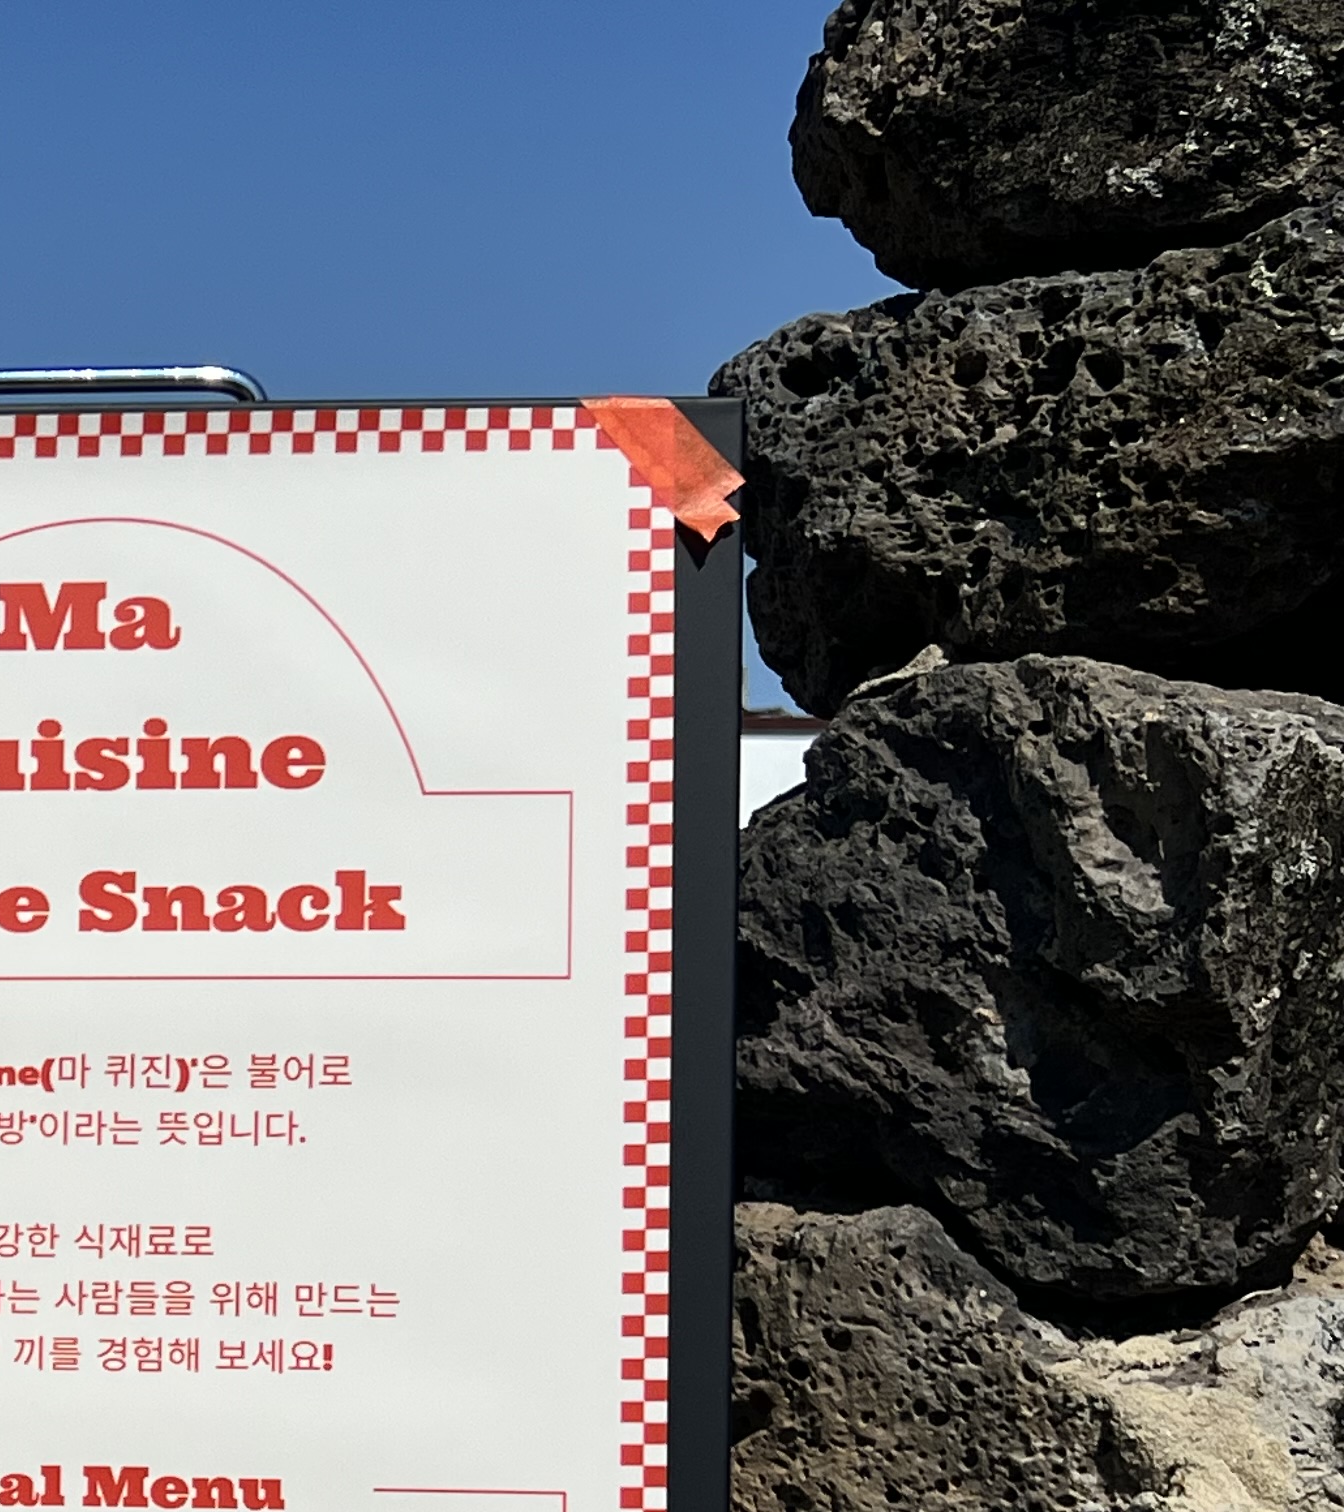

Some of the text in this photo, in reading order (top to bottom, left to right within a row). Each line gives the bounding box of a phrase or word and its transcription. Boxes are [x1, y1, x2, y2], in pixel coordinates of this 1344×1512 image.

[79, 870, 406, 933] Snack
[104, 1053, 232, 1093] 퀴진)'은
[247, 1053, 352, 1089] 불어로
[157, 1111, 306, 1146] 뜻입니다.
[74, 1224, 214, 1259] 식재료로
[55, 1280, 195, 1315] 사람들을
[210, 1281, 277, 1317] 위해
[295, 1282, 400, 1317] 만드는
[14, 1336, 81, 1371] 끼를
[97, 1337, 199, 1372] 경험해
[216, 1339, 333, 1374] 보세요!
[82, 1466, 285, 1511] Menu
